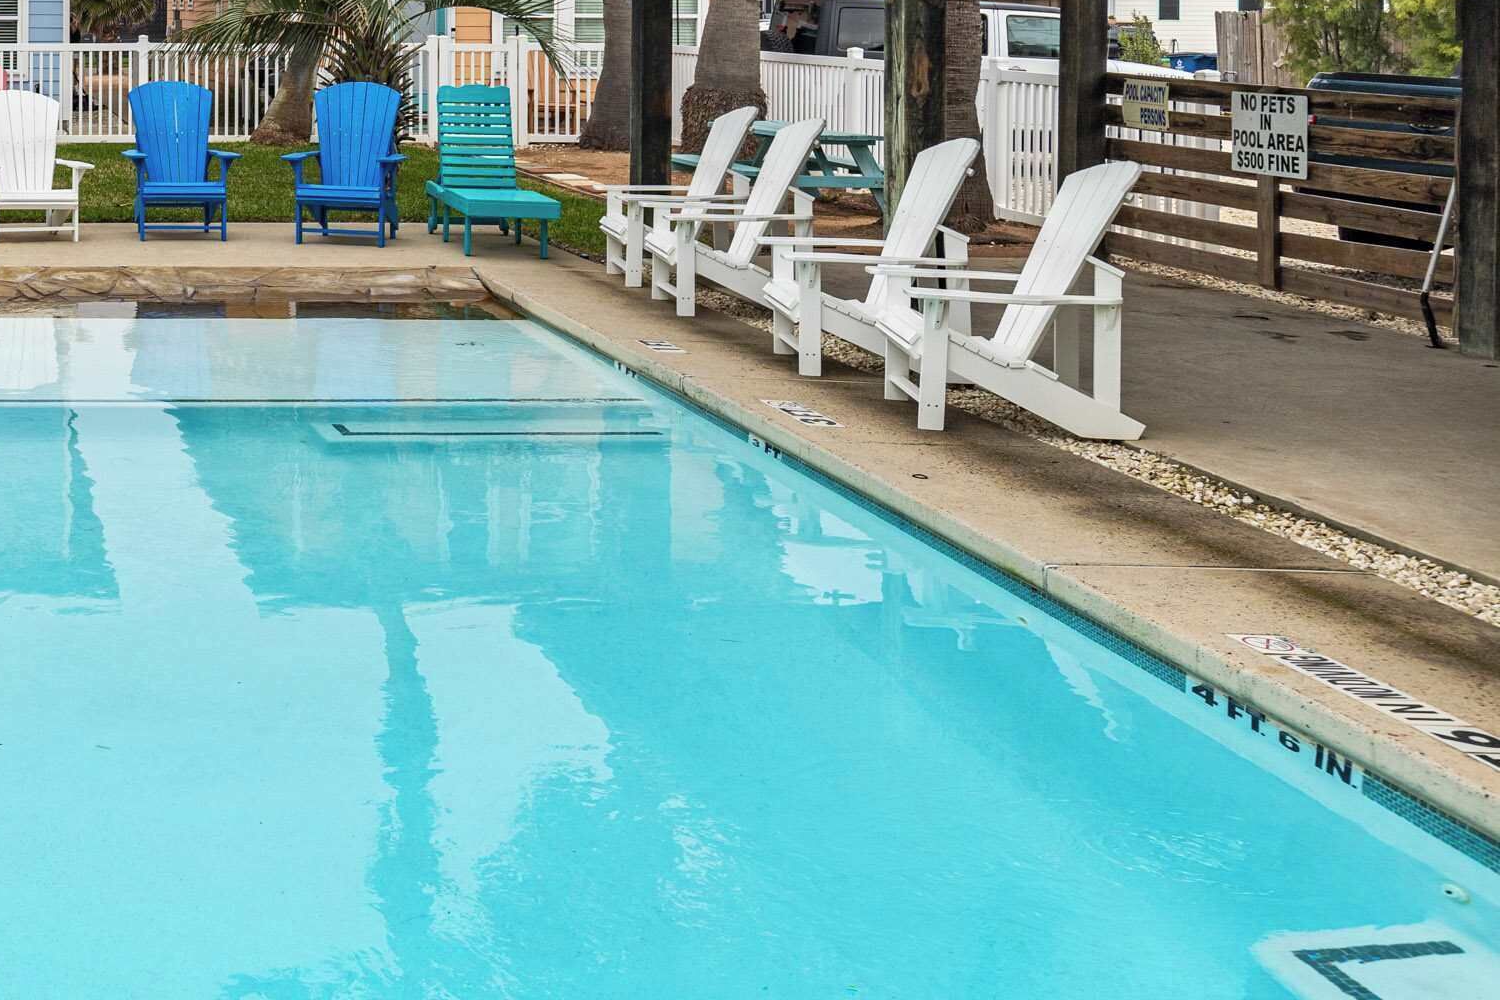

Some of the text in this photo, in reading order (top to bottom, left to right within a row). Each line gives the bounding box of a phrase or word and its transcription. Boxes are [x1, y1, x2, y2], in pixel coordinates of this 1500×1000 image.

[1125, 83, 1166, 105] POOL CAPACITY
[1240, 93, 1296, 115] NO PETS
[1140, 107, 1166, 127] PERSONS
[1260, 114, 1272, 131] IN
[1233, 129, 1305, 153] POOL AREA
[1237, 152, 1300, 174] $500 FINE
[764, 441, 781, 459] FT
[1191, 684, 1218, 708] 4
[1278, 730, 1301, 753] 6
[1376, 703, 1455, 722] IN
